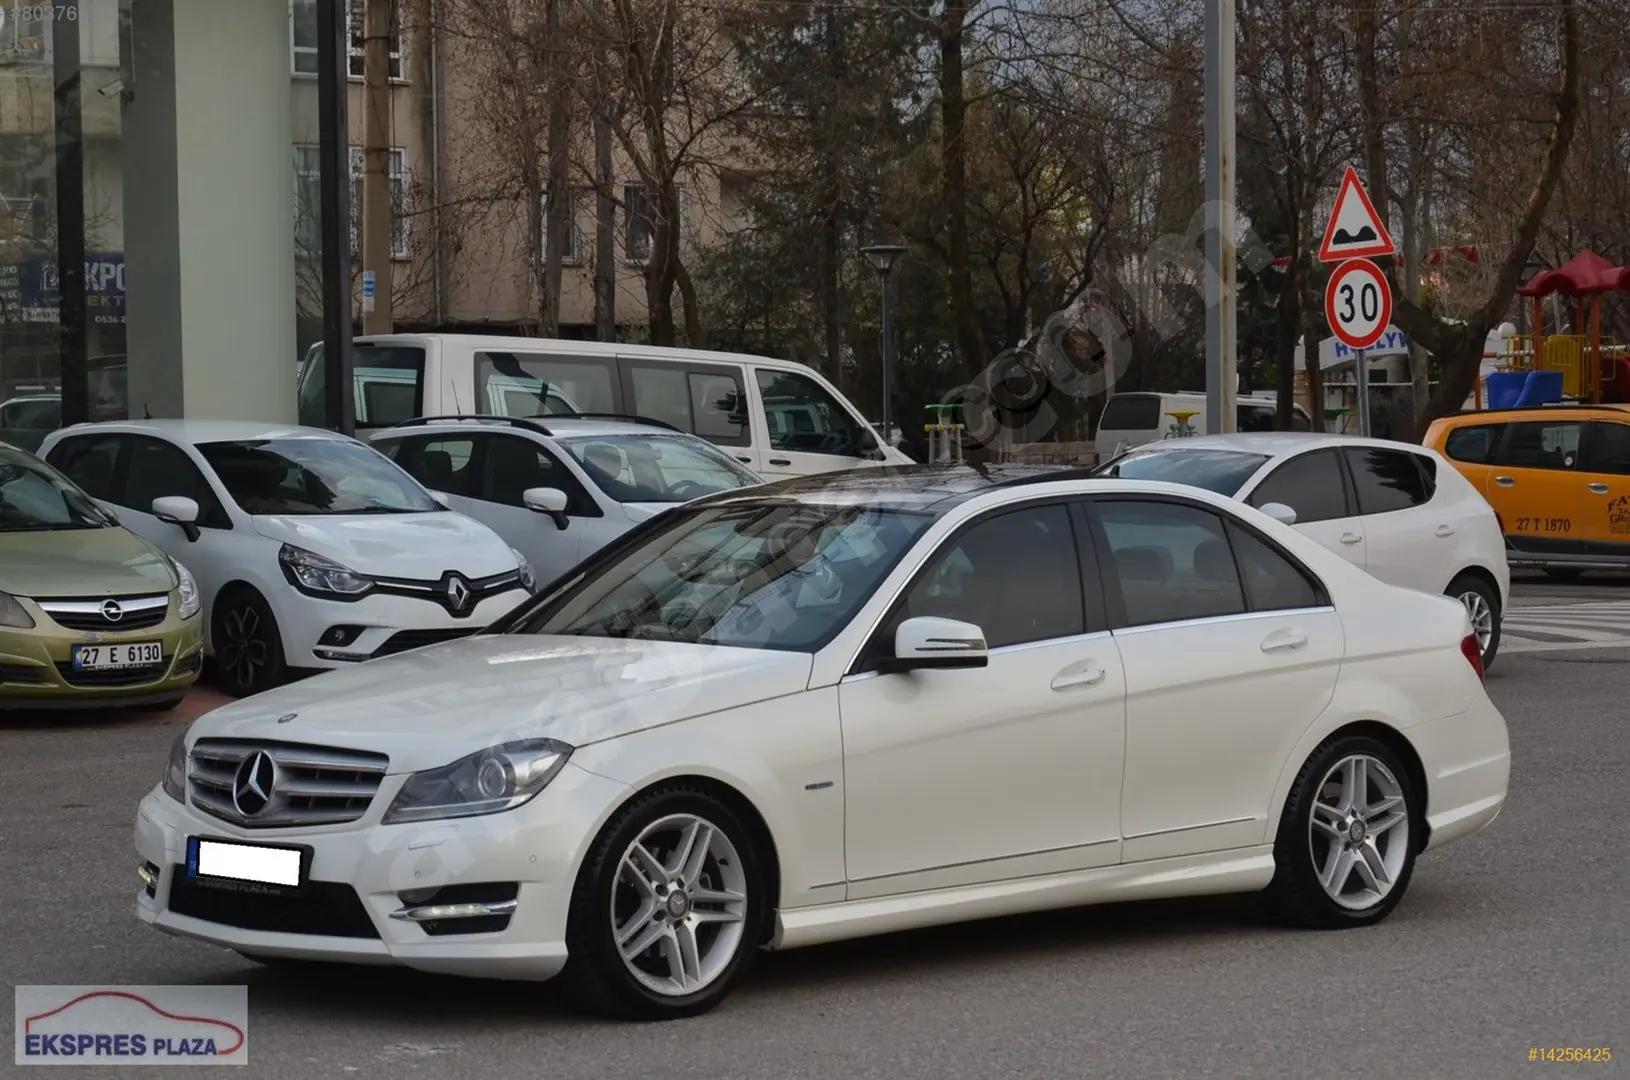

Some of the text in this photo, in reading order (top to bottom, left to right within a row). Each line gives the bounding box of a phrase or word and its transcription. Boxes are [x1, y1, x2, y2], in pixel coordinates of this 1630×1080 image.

[1339, 283, 1378, 323] 30
[1517, 518, 1571, 532] 27 T 1870
[82, 644, 159, 665] 27 E 6130
